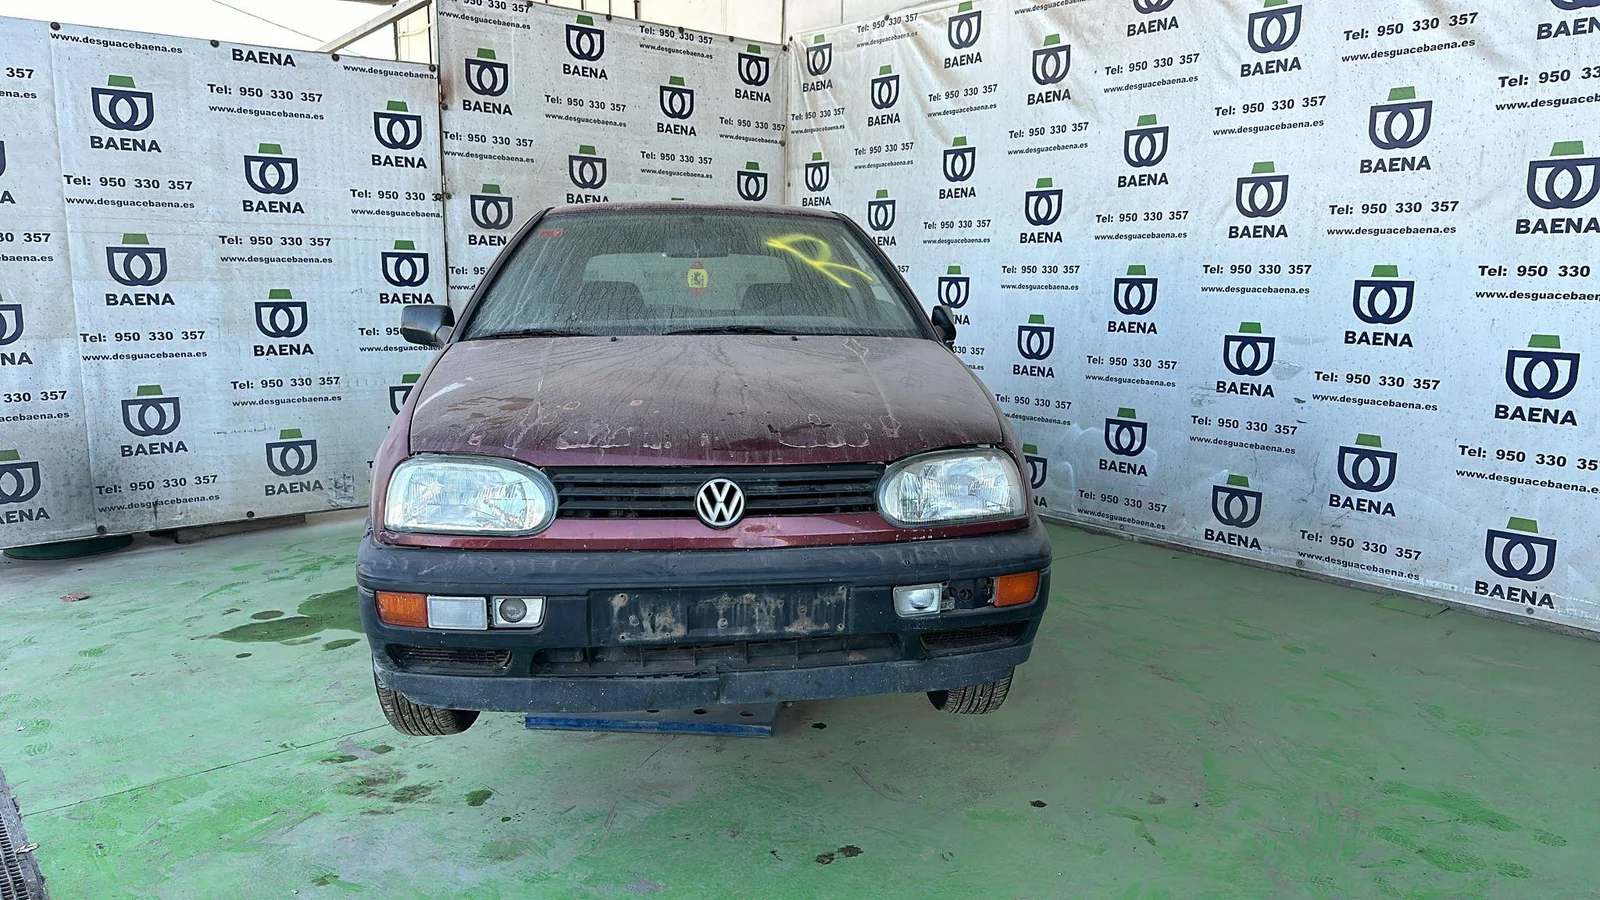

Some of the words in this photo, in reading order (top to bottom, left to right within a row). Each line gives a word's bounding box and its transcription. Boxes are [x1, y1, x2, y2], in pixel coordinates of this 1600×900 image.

[438, 10, 530, 29] www.desguacebaena.es
[1126, 15, 1179, 37] BAENA
[1343, 28, 1368, 40] Tel:
[1377, 22, 1403, 36] 950
[1412, 17, 1439, 31] 330
[1448, 11, 1478, 26] 357
[49, 32, 182, 53] www.desguacebaena.es
[1341, 39, 1475, 62] www.desguacebaena.es
[231, 48, 296, 67] BAENA
[639, 43, 713, 59] www.desguacebaena.es
[943, 51, 982, 69] BAENA
[1104, 64, 1123, 75] Tel:
[1128, 60, 1147, 72] 950
[1153, 56, 1173, 68] 330
[1179, 52, 1199, 64] 357
[1240, 56, 1301, 77] BAENA
[562, 63, 608, 80] BAENA
[802, 78, 832, 92] BAENA
[1103, 75, 1198, 93] www.desguacebaena.es
[206, 83, 231, 94] Tel:
[239, 86, 263, 97] 950
[270, 89, 293, 100] 330
[300, 92, 322, 102] 357
[734, 88, 771, 103] BAENA
[927, 92, 941, 102] Tel:
[944, 89, 959, 99] 950
[963, 86, 978, 96] 330
[982, 83, 997, 93] 357
[1027, 88, 1071, 105] BAENA
[462, 99, 512, 115] BAENA
[544, 94, 562, 104] Tel:
[566, 97, 583, 107] 950
[588, 99, 605, 109] 330
[610, 102, 626, 112] 357
[208, 105, 324, 120] www.desguacebaena.es
[544, 113, 626, 127] www.desguacebaena.es
[867, 112, 900, 126] BAENA
[656, 122, 696, 136] BAENA
[718, 116, 733, 125] Tel:
[737, 118, 751, 127] 950
[754, 120, 768, 129] 330
[772, 121, 786, 131] 357
[1008, 129, 1024, 138] Tel:
[1028, 126, 1045, 136] 950
[1049, 124, 1066, 134] 330
[1071, 121, 1089, 132] 357
[1212, 119, 1324, 135] www.desguacebaena.es
[89, 135, 162, 152] BAENA
[854, 147, 866, 155] Tel:
[869, 145, 881, 154] 950
[884, 143, 897, 152] 330
[900, 141, 914, 150] 357
[1007, 142, 1088, 155] www.desguacebaena.es
[371, 153, 427, 169] BAENA
[443, 149, 534, 163] www.desguacebaena.es
[640, 150, 655, 159] Tel:
[659, 152, 675, 161] 950
[679, 154, 694, 163] 330
[698, 156, 712, 164] 357
[1359, 155, 1431, 173] BAENA
[63, 174, 91, 185] Tel:
[99, 176, 125, 187] 950
[134, 178, 159, 188] 330
[167, 180, 192, 190] 357
[1117, 172, 1168, 188] BAENA
[938, 186, 976, 199] BAENA
[65, 197, 194, 208] www.desguacebaena.es
[242, 199, 304, 213] BAENA
[802, 196, 831, 206] BAENA
[1328, 204, 1353, 214] Tel:
[1361, 202, 1387, 214] 950
[1395, 201, 1422, 213] 330
[1430, 200, 1459, 212] 357
[923, 221, 936, 229] Tel:
[940, 220, 954, 229] 950
[957, 219, 972, 228] 330
[976, 219, 991, 227] 357
[1095, 213, 1113, 223] Tel:
[1118, 212, 1137, 222] 950
[1143, 211, 1162, 221] 330
[1168, 210, 1188, 220] 357
[1228, 224, 1288, 238] BAENA
[1326, 225, 1456, 236] www.desguacebaena.es
[1515, 217, 1600, 234] BAENA
[218, 235, 242, 244] Tel:
[249, 235, 273, 245] 950
[279, 236, 302, 246] 330
[309, 237, 331, 246] 357
[1019, 231, 1062, 243] BAENA
[1094, 231, 1187, 241] www.desguacebaena.es
[219, 255, 332, 264] www.desguacebaena.es
[1001, 265, 1016, 273] Tel:
[1021, 265, 1037, 273] 950
[1041, 265, 1058, 273] 330
[1062, 265, 1080, 273] 357
[1202, 264, 1223, 273] Tel:
[1230, 264, 1251, 274] 950
[1258, 264, 1281, 274] 330
[1288, 264, 1311, 274] 357
[1000, 283, 1078, 291] www.desguacebaena.es
[1200, 285, 1309, 294] www.desguacebaena.es
[105, 293, 175, 305] BAENA
[379, 292, 434, 304] BAENA
[1107, 320, 1157, 334] BAENA
[79, 332, 106, 342] Tel:
[114, 331, 140, 341] 950
[148, 331, 173, 340] 330
[181, 330, 205, 340] 357
[1344, 330, 1413, 347] BAENA
[81, 351, 207, 361] www.desguacebaena.es
[253, 343, 314, 356] BAENA
[1086, 354, 1103, 364] Tel:
[1108, 356, 1127, 366] 950
[1132, 358, 1151, 368] 330
[1157, 359, 1177, 369] 357
[1012, 363, 1054, 378] BAENA
[1084, 374, 1175, 387] www.desguacebaena.es
[1314, 370, 1338, 382] Tel:
[1345, 373, 1370, 384] 950
[1378, 375, 1404, 387] 330
[1412, 378, 1440, 390] 357
[1215, 380, 1274, 397] BAENA
[232, 395, 341, 406] www.desguacebaena.es
[1312, 393, 1437, 411] www.desguacebaena.es
[1494, 403, 1577, 426] BAENA
[120, 440, 188, 457] BAENA
[1189, 435, 1295, 454] www.desguacebaena.es
[1098, 458, 1147, 476] BAENA
[264, 479, 324, 496] BAENA
[1078, 489, 1095, 500] Tel:
[1100, 493, 1118, 504] 950
[1123, 497, 1142, 508] 330
[1147, 501, 1167, 512] 357
[1328, 493, 1395, 517] BAENA
[1077, 507, 1166, 530] www.desguacebaena.es
[1204, 527, 1261, 550] BAENA
[1299, 529, 1322, 542] Tel:
[1329, 535, 1354, 548] 950
[1361, 540, 1387, 554] 330
[1394, 547, 1421, 560] 357
[1298, 550, 1420, 580] www.desguacebaena.es
[1474, 579, 1554, 609] BAENA
